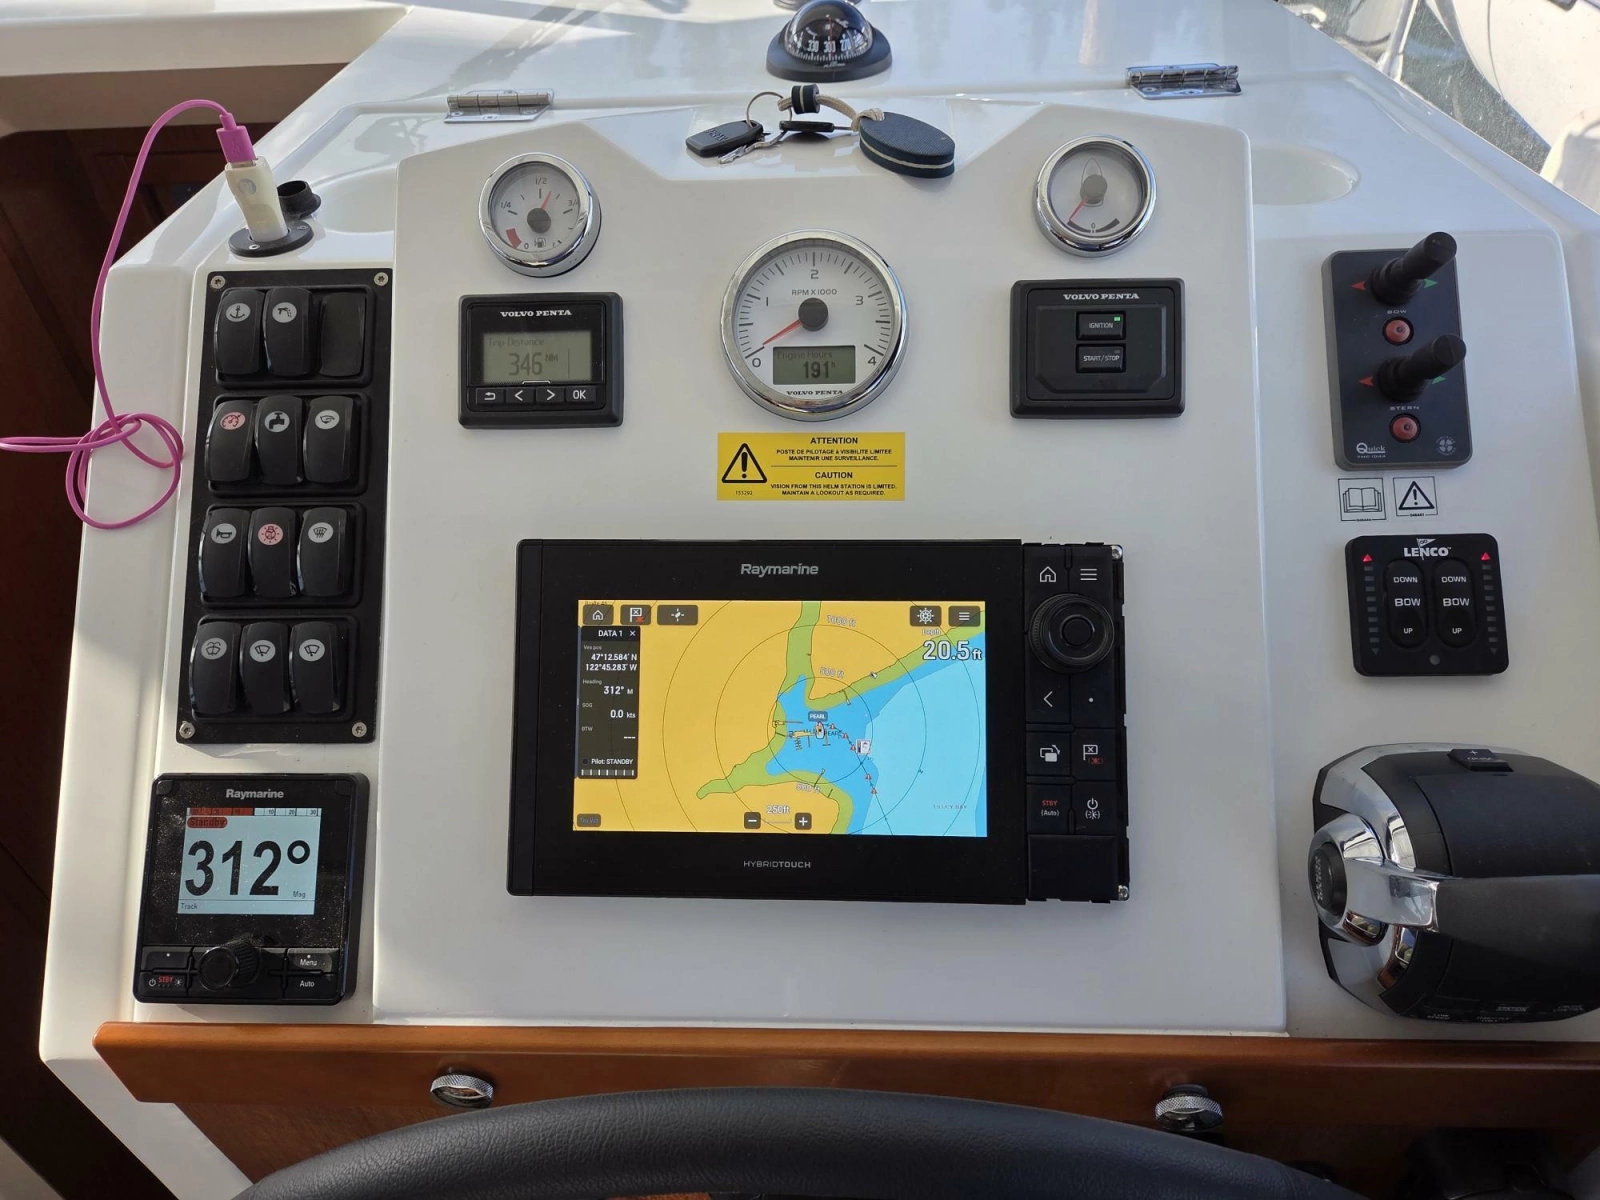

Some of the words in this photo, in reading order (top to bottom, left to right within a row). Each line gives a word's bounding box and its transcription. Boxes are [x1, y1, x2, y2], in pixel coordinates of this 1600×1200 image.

[824, 40, 836, 52] 300
[810, 269, 819, 280] 2
[855, 295, 864, 306] 3
[488, 337, 504, 348] Trip
[507, 336, 544, 346] Distance
[777, 351, 806, 360] Engine
[808, 350, 833, 358] Hours
[508, 352, 542, 376] 346
[752, 358, 762, 368] 0
[868, 356, 877, 366] 4
[803, 361, 829, 379] 191
[572, 389, 586, 400] OK
[1356, 443, 1386, 454] Quick
[1404, 547, 1449, 558] LENCO
[740, 563, 819, 578] Raymarine
[1394, 598, 1420, 606] BOW
[1442, 598, 1470, 606] BOW
[603, 686, 624, 695] 312°
[610, 710, 624, 718] 0.0
[225, 788, 284, 800] Raymarine
[190, 818, 224, 828] Standby
[185, 840, 310, 896] 312°
[743, 860, 811, 868] HYBRIDTOUCH
[292, 890, 306, 899] Mag
[158, 976, 173, 984] STBY
